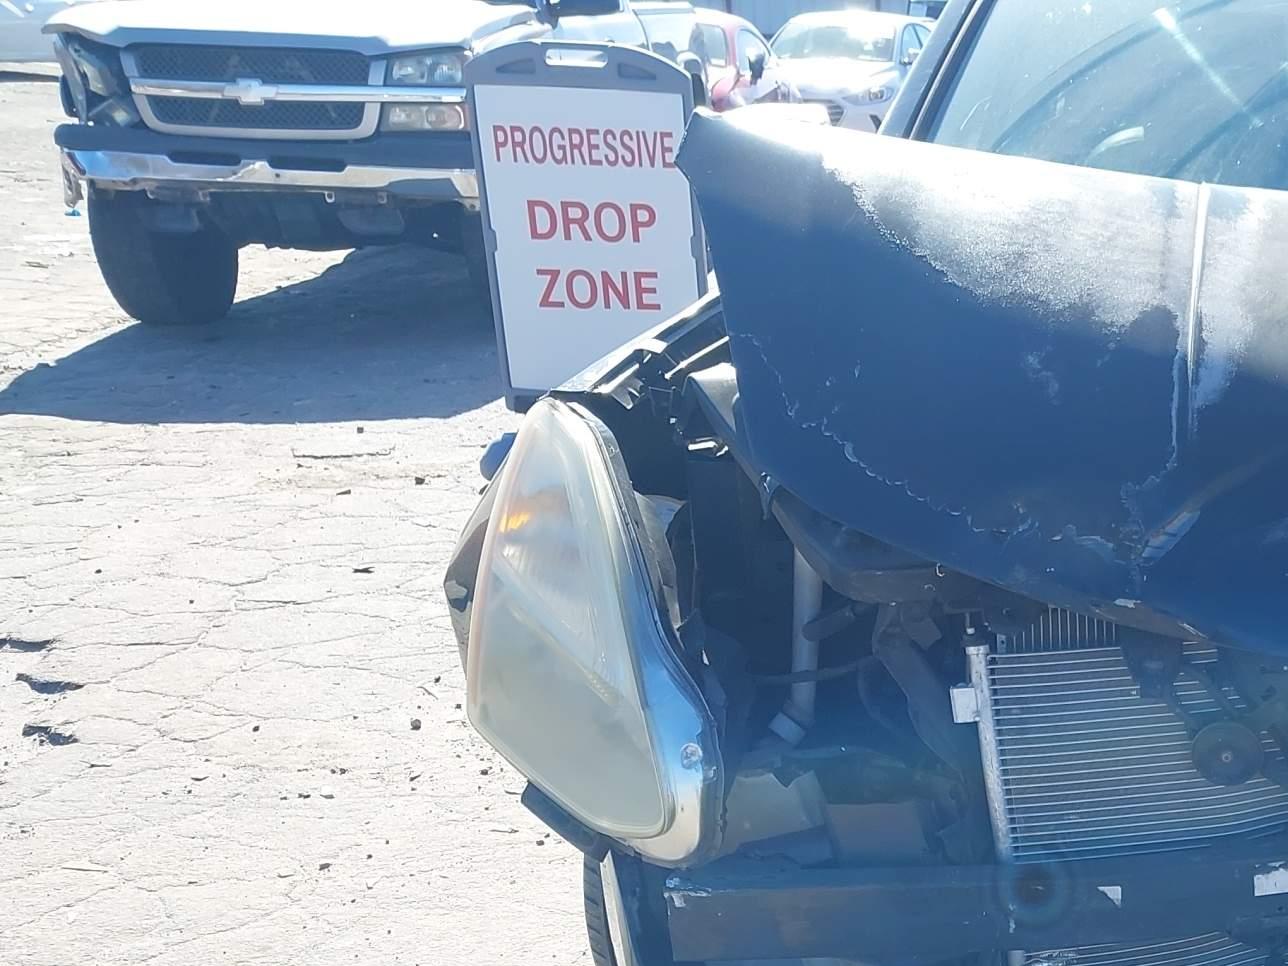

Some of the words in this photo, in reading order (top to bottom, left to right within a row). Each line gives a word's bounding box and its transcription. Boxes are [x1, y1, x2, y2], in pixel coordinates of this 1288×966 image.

[492, 125, 676, 169] PROGRESSIVE
[526, 200, 657, 243] DROP
[536, 269, 662, 310] ZONE
